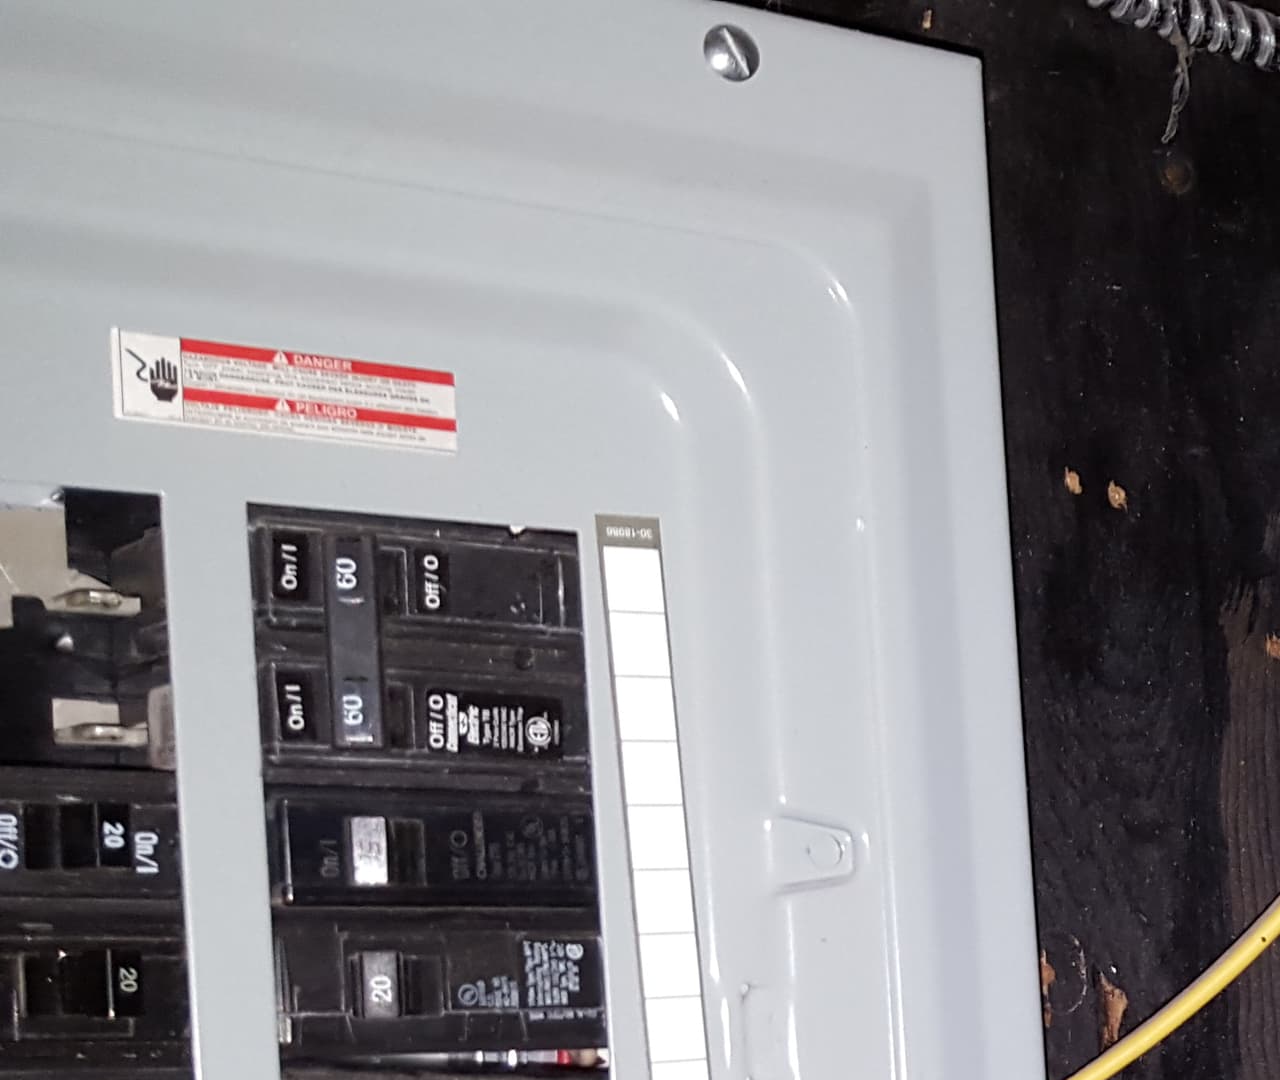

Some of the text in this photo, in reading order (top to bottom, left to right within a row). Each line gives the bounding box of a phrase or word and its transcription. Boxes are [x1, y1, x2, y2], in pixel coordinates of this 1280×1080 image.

[293, 354, 352, 371] DANGER
[296, 401, 357, 420] PELIGRO
[335, 557, 358, 590] 60
[343, 694, 363, 727] 60
[103, 820, 125, 849] 20
[118, 966, 138, 994] 20
[372, 975, 392, 1002] 20
